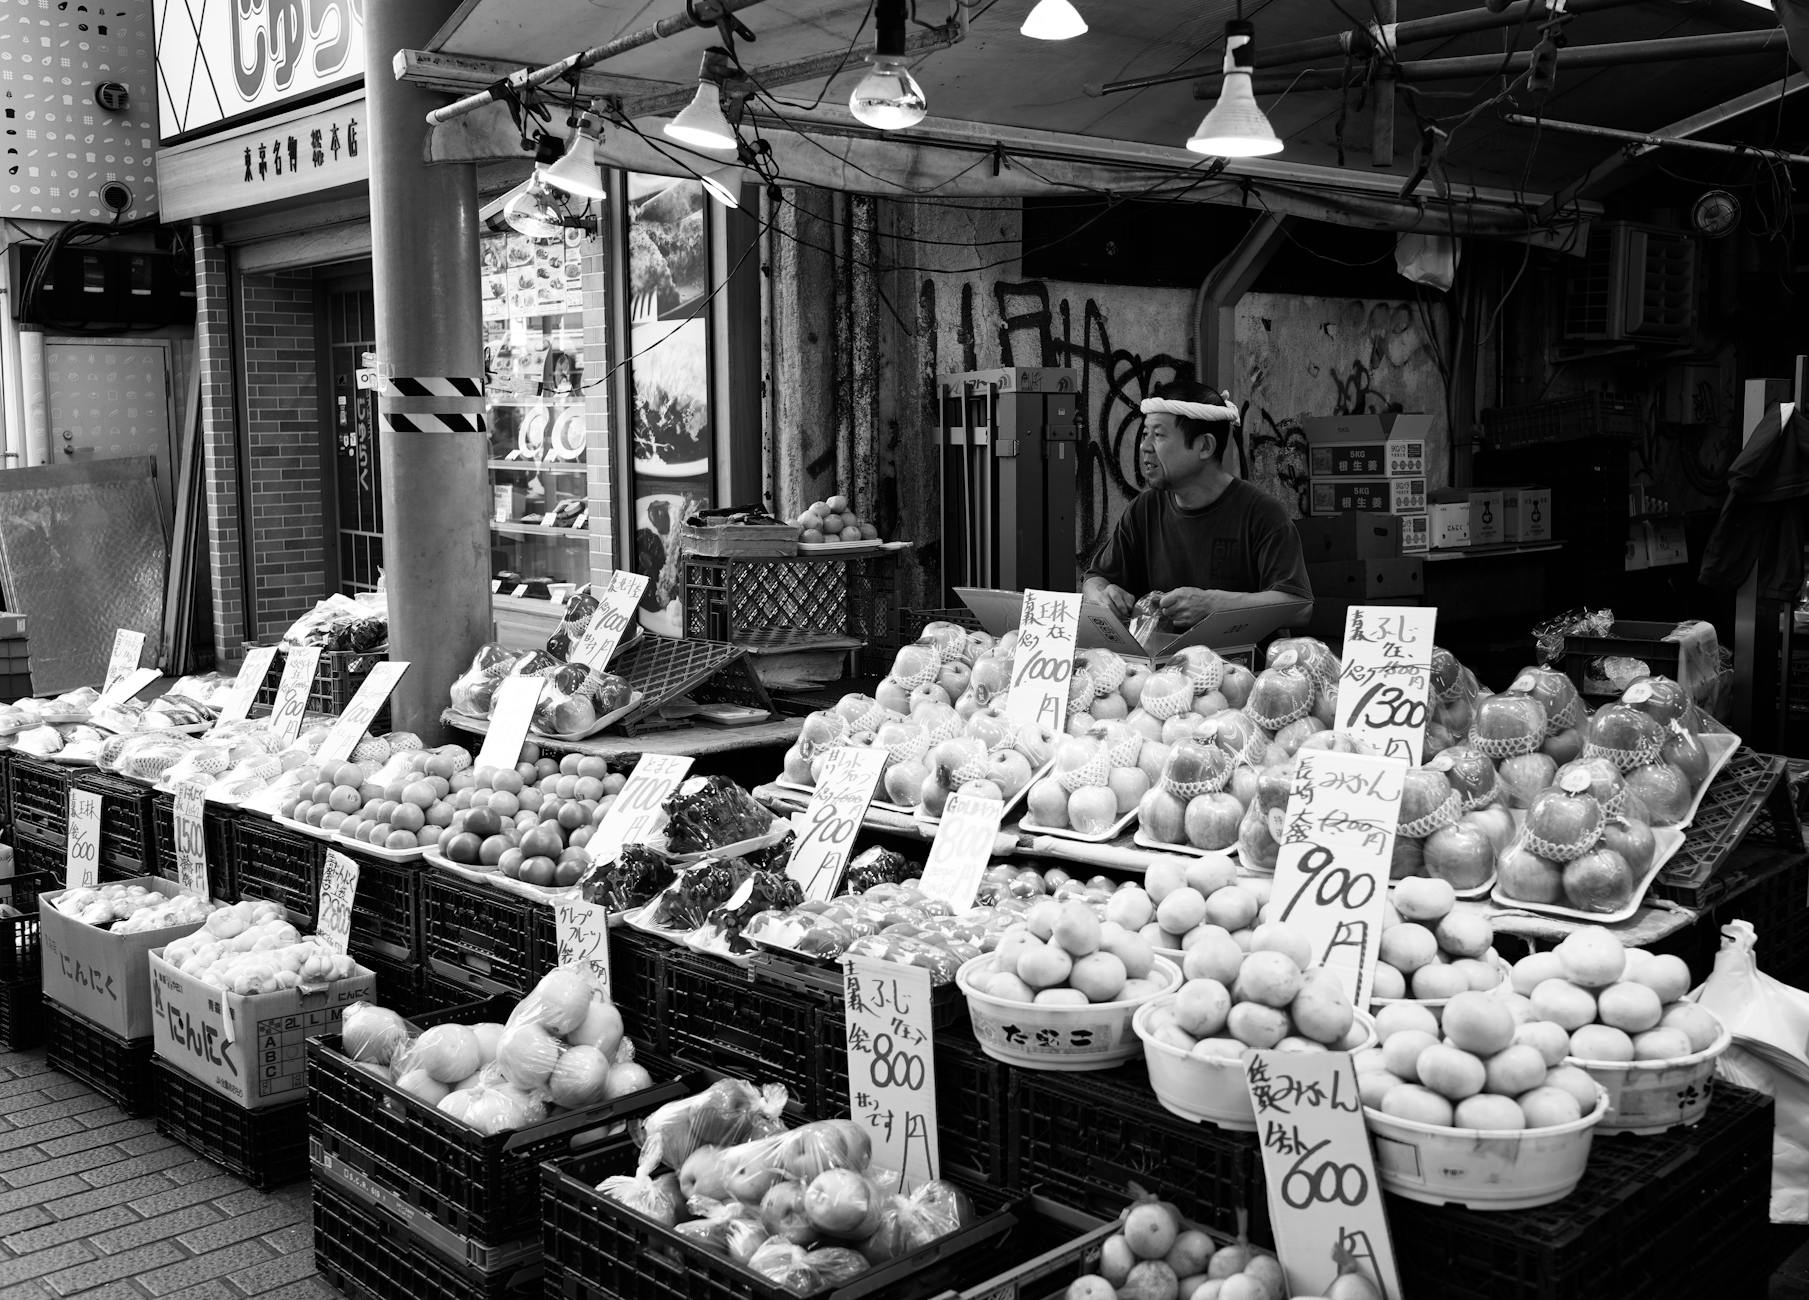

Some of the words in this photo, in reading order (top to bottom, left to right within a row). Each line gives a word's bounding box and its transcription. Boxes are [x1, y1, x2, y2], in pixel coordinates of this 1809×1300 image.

[1349, 450, 1366, 459] 5KG
[1353, 487, 1370, 496] 5KG
[1370, 615, 1419, 644] ふじ
[1036, 692, 1059, 730] 円
[617, 776, 672, 813] 700
[1319, 770, 1401, 802] みかん
[72, 831, 95, 861] 600
[622, 815, 650, 844] 円
[793, 804, 855, 861] 900
[1362, 831, 1387, 855] 円
[195, 862, 205, 892] 円
[806, 851, 842, 901] 円
[1279, 845, 1377, 923] 900
[60, 951, 117, 1001] にんにく
[1318, 920, 1369, 1007] 円
[337, 986, 370, 1003] にんにく
[870, 979, 912, 1015] ふじ
[168, 1001, 238, 1078] にんにく
[284, 1017, 301, 1030] 2L
[310, 1014, 319, 1025] L
[265, 1035, 276, 1048] A
[265, 1050, 276, 1062] B
[265, 1064, 276, 1078] C
[870, 1033, 926, 1091] 800
[1274, 1070, 1360, 1113] みかん
[898, 1111, 935, 1195] 円
[1281, 1139, 1369, 1210] 600
[1337, 1226, 1389, 1299] 円
